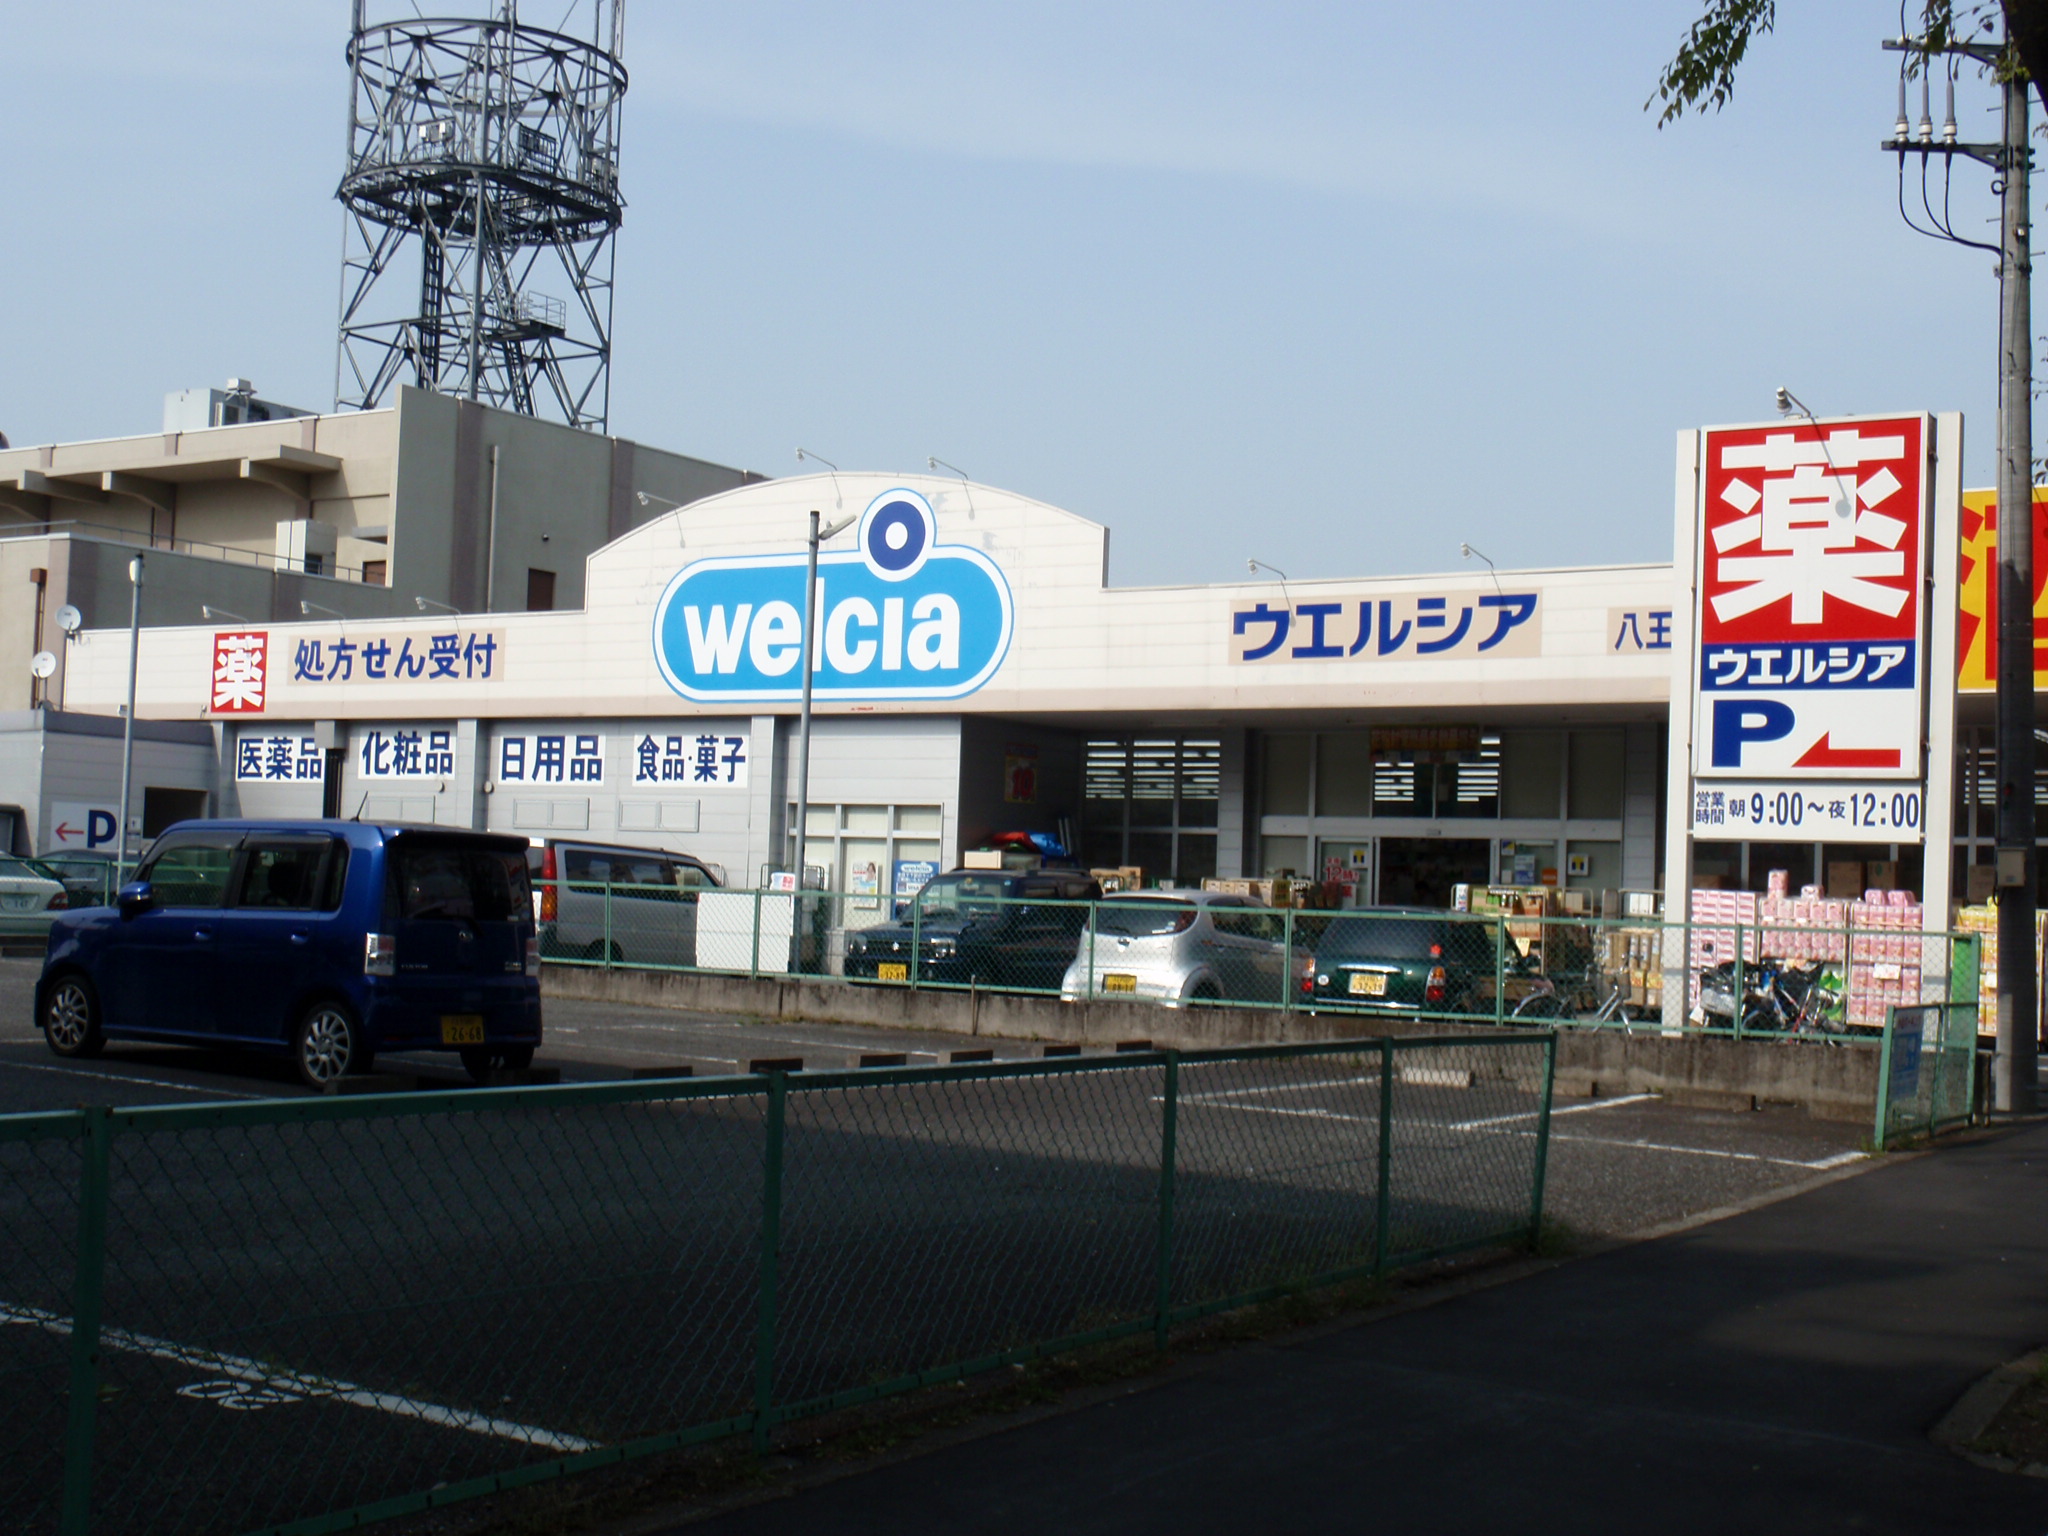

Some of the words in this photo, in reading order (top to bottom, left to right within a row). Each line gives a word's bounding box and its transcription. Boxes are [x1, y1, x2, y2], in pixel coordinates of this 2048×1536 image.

[1710, 429, 1909, 624] 薬
[684, 499, 960, 677] welcia
[1233, 593, 1538, 661] ウエルシア
[213, 635, 263, 710] 薬
[294, 633, 497, 682] 処方せん受付
[1709, 646, 1906, 686] ウエルシア
[362, 730, 453, 776] 化粧品
[1711, 699, 1796, 768] P
[237, 736, 322, 780] 医薬品
[501, 735, 602, 782] 日用品
[636, 735, 746, 783] 食品・菓子
[1696, 791, 1725, 808] 営業
[1696, 808, 1725, 825] 時間
[87, 810, 117, 848] P
